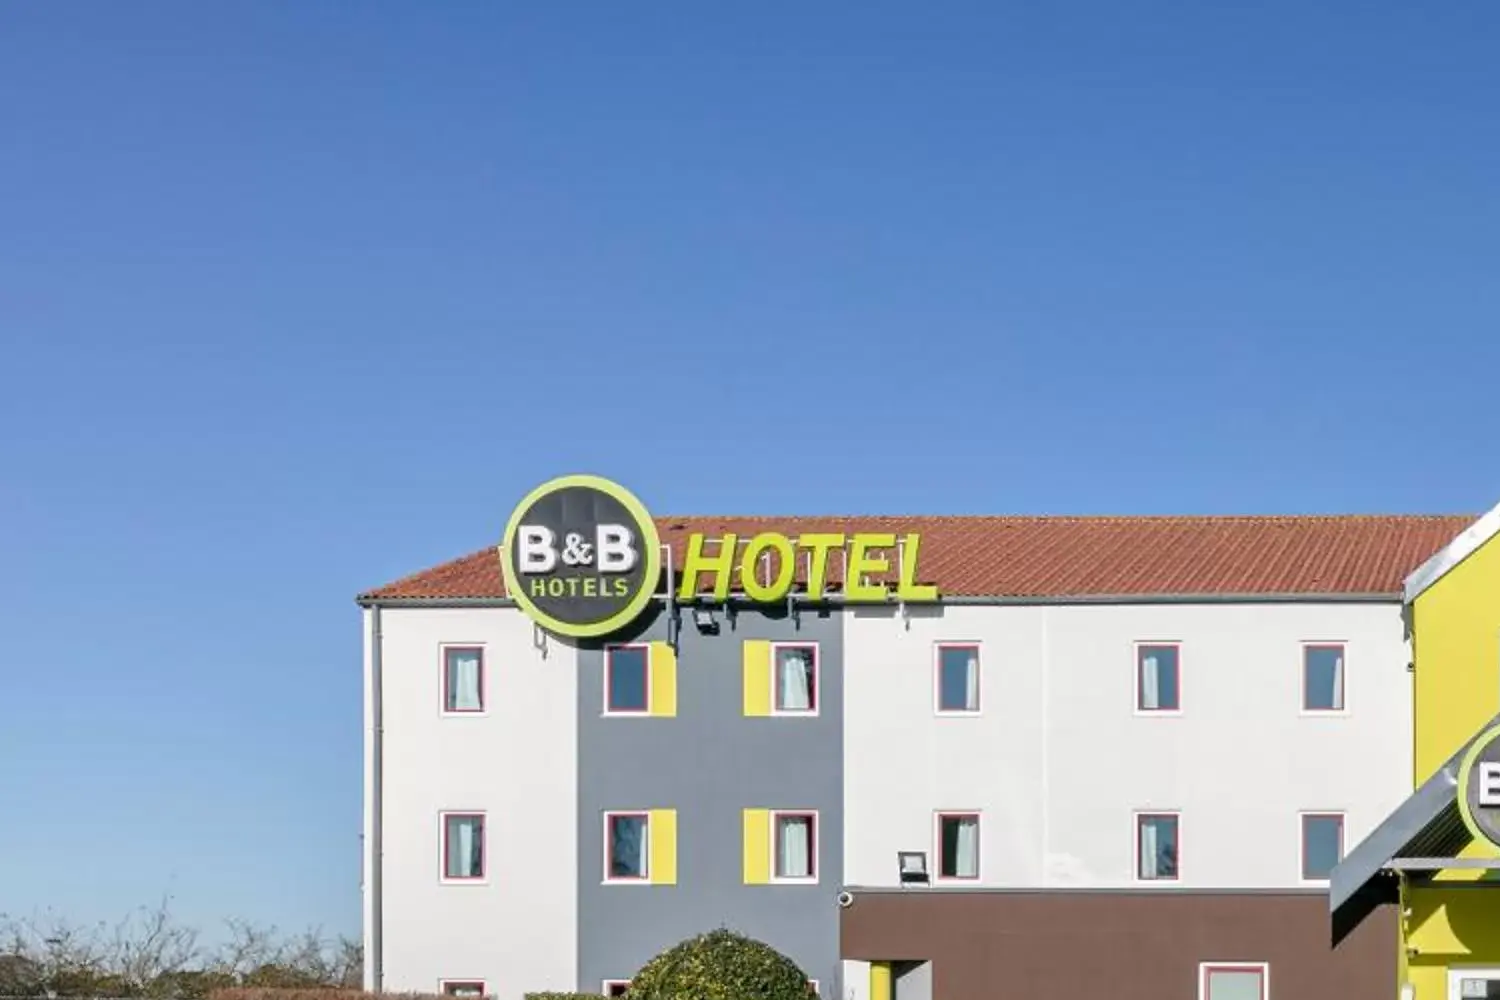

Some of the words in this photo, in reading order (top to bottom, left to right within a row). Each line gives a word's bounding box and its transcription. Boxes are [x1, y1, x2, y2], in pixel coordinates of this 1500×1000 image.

[519, 525, 636, 573] B&B
[677, 532, 938, 602] HOTEL
[531, 578, 628, 597] HOTELS
